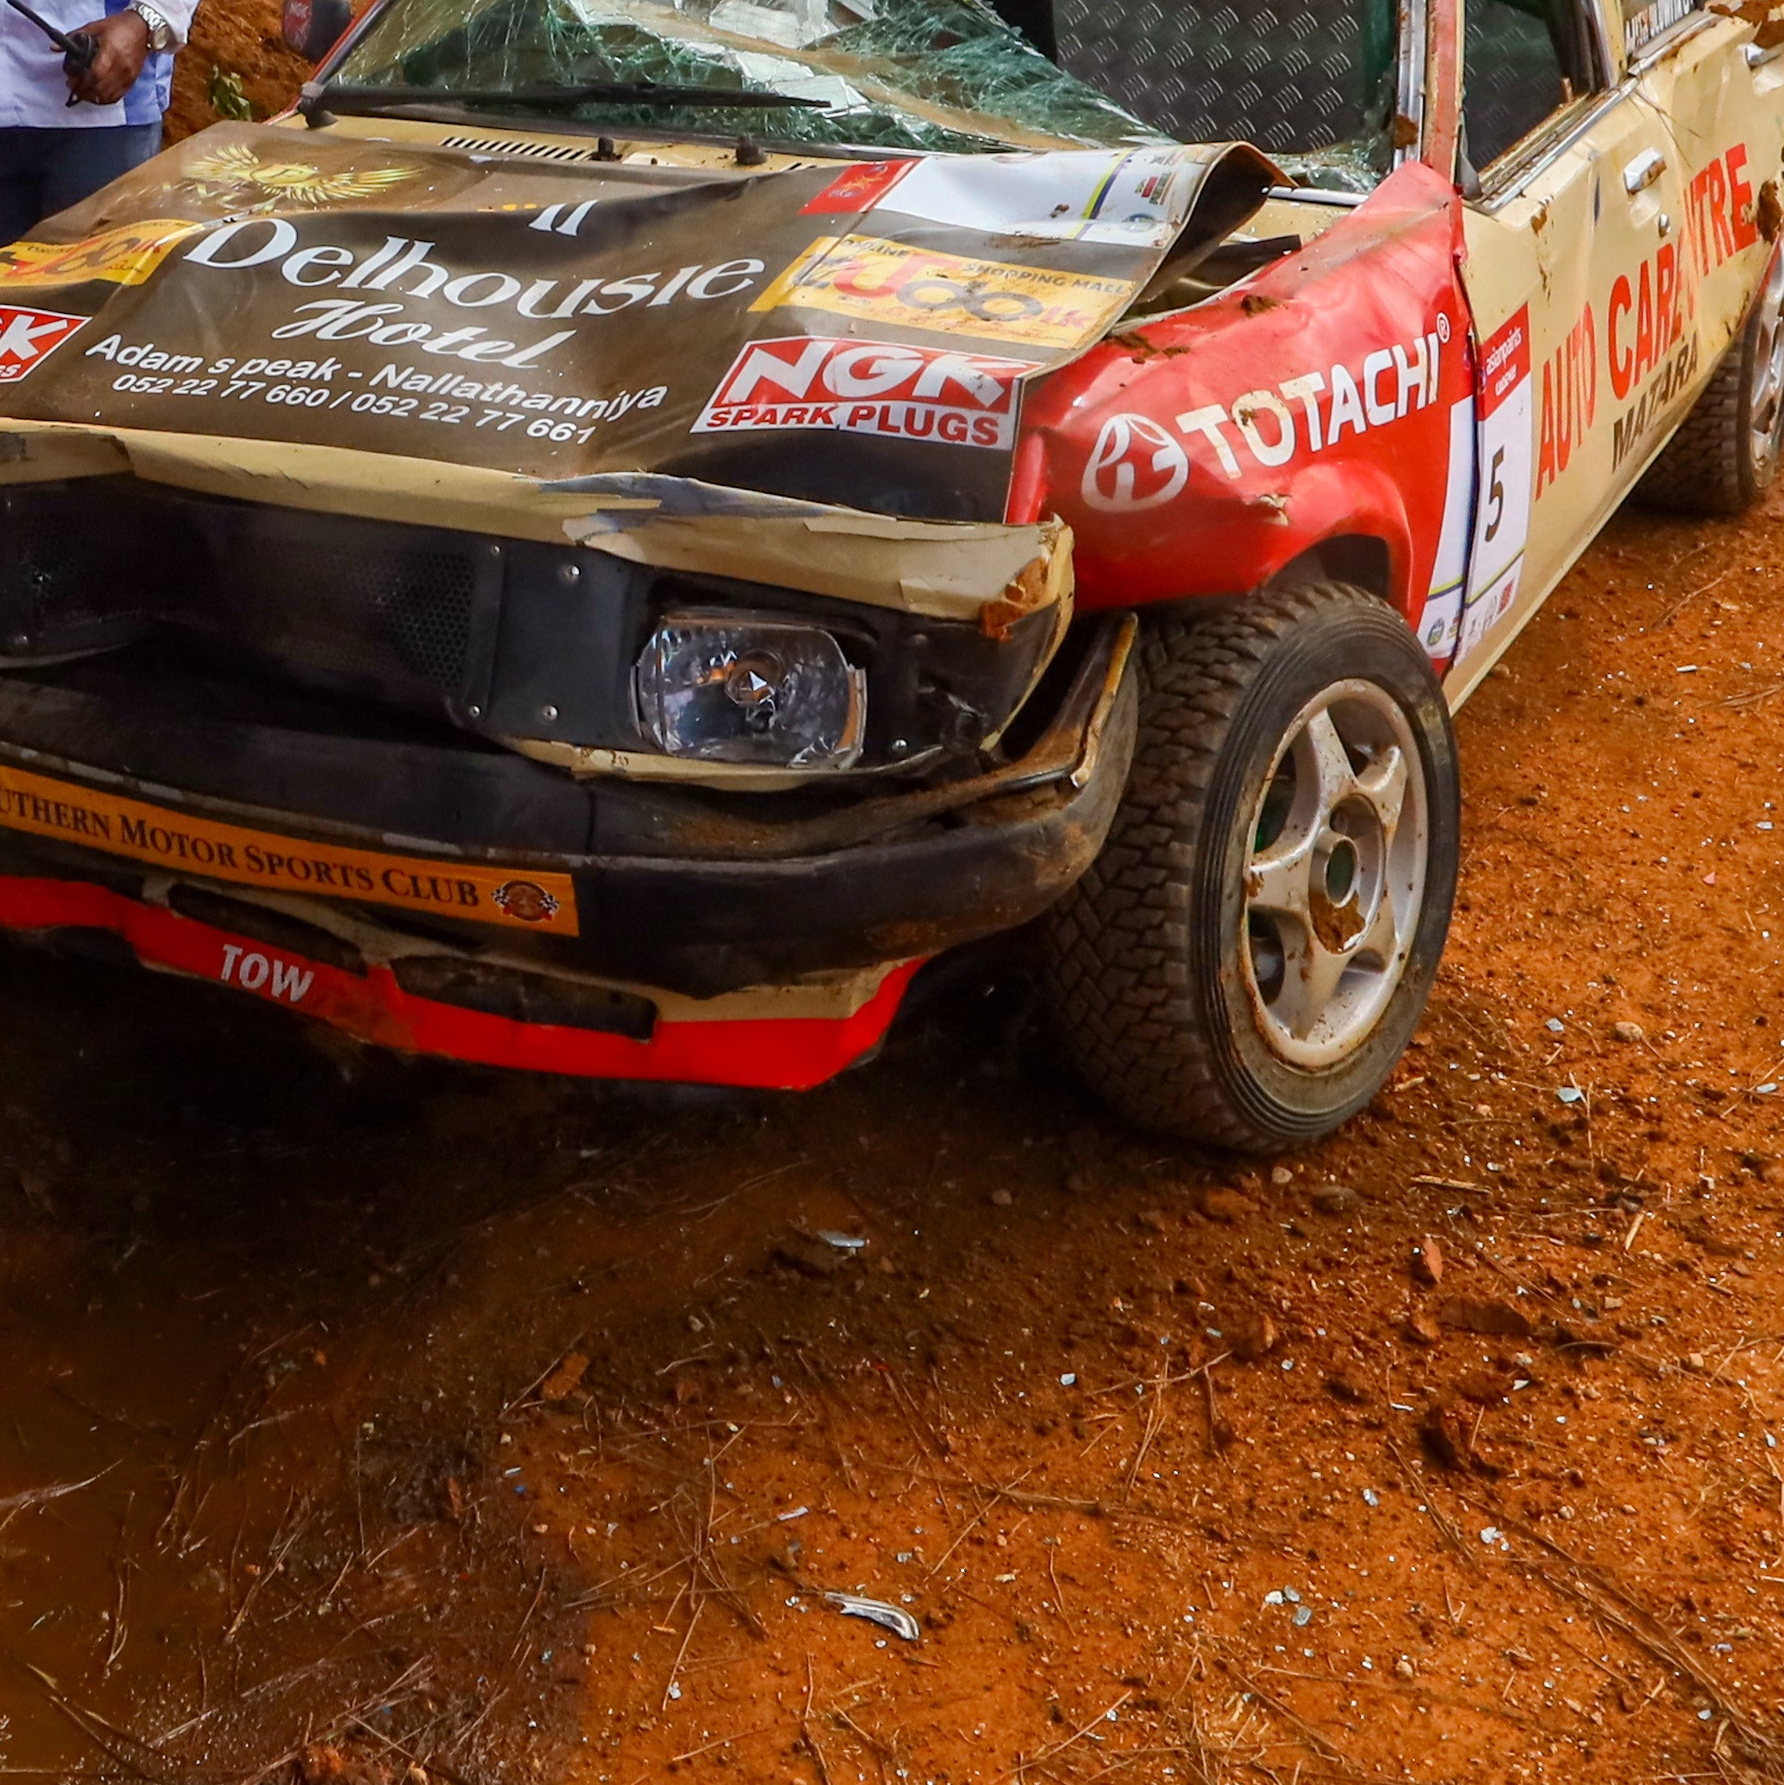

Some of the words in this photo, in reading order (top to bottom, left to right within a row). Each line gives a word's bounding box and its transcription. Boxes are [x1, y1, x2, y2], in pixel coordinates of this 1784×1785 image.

[963, 262, 1067, 288] SHOPPING
[1070, 277, 1127, 297] MALL
[272, 299, 576, 370] Hotel
[1486, 326, 1523, 377] asianpaints
[85, 333, 205, 375] Adam
[236, 356, 343, 383] peak
[369, 362, 669, 423] Nallathanniya
[112, 373, 176, 396] 052
[170, 378, 218, 398] 22
[220, 380, 266, 401] 77
[265, 384, 329, 409] 660
[350, 391, 419, 418] 052
[419, 401, 472, 425] 22
[474, 409, 526, 433] 77
[526, 418, 597, 446] 661
[727, 341, 1015, 409] NGK
[1175, 331, 1442, 480] TOTACHI
[1535, 300, 1597, 502] AUTO
[1612, 330, 1700, 474] MATARA
[706, 403, 837, 429] SPARK
[846, 404, 1001, 447] PLUGS
[1484, 448, 1507, 544] 5
[118, 813, 239, 870] MOTOR
[244, 845, 375, 891] SPORTS
[381, 867, 480, 907] CLUB
[218, 943, 315, 1004] TOW
